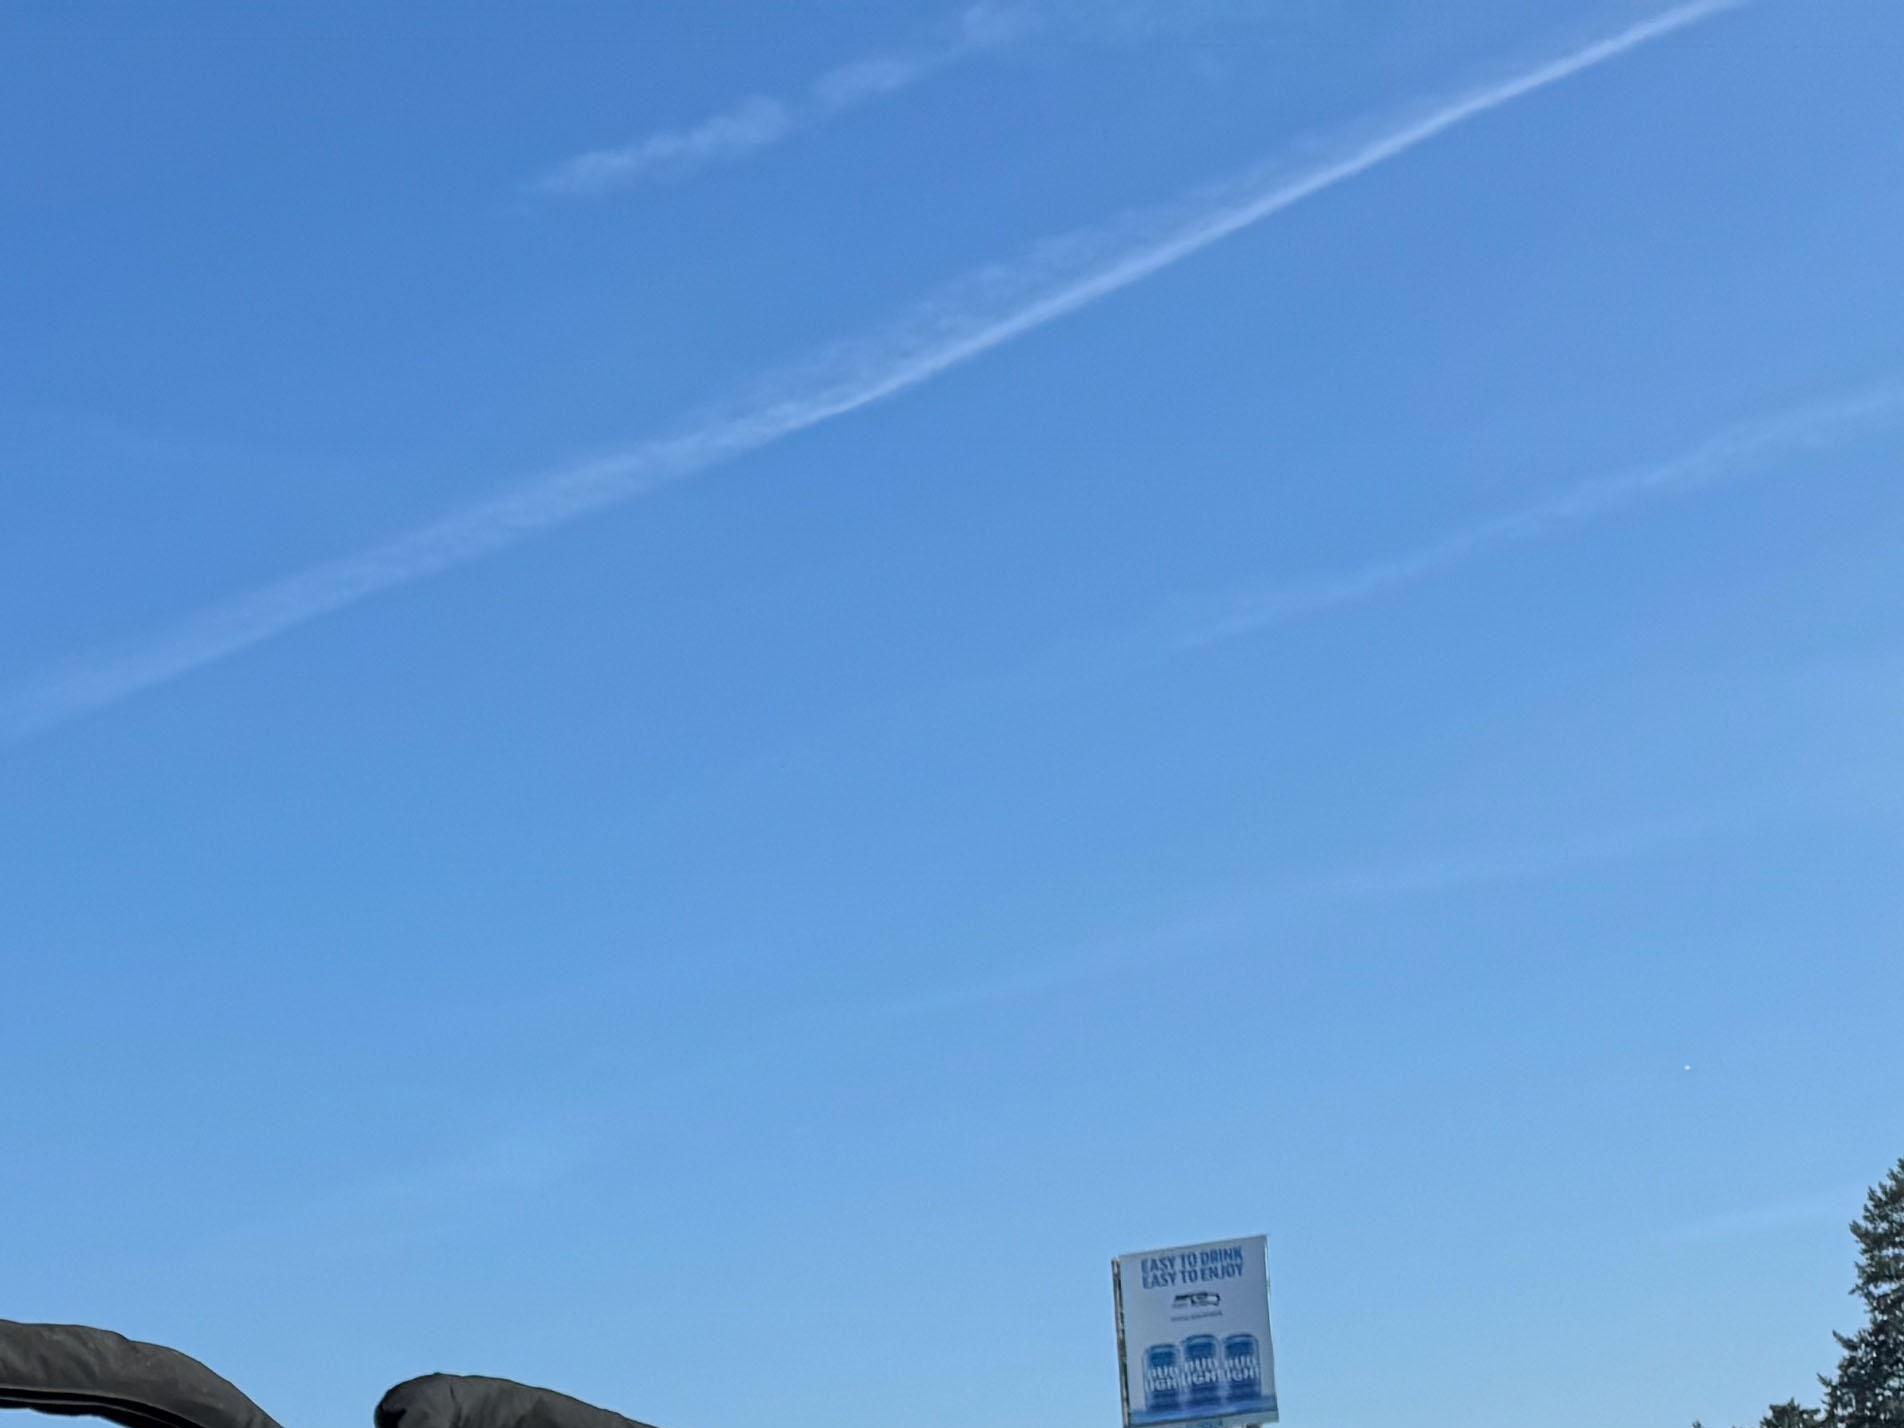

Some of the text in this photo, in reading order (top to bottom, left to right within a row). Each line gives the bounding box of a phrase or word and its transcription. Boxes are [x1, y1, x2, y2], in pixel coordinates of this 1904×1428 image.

[1141, 1246, 1243, 1273] EASY TO DRINK
[1142, 1262, 1243, 1289] EASY TO ENJOY
